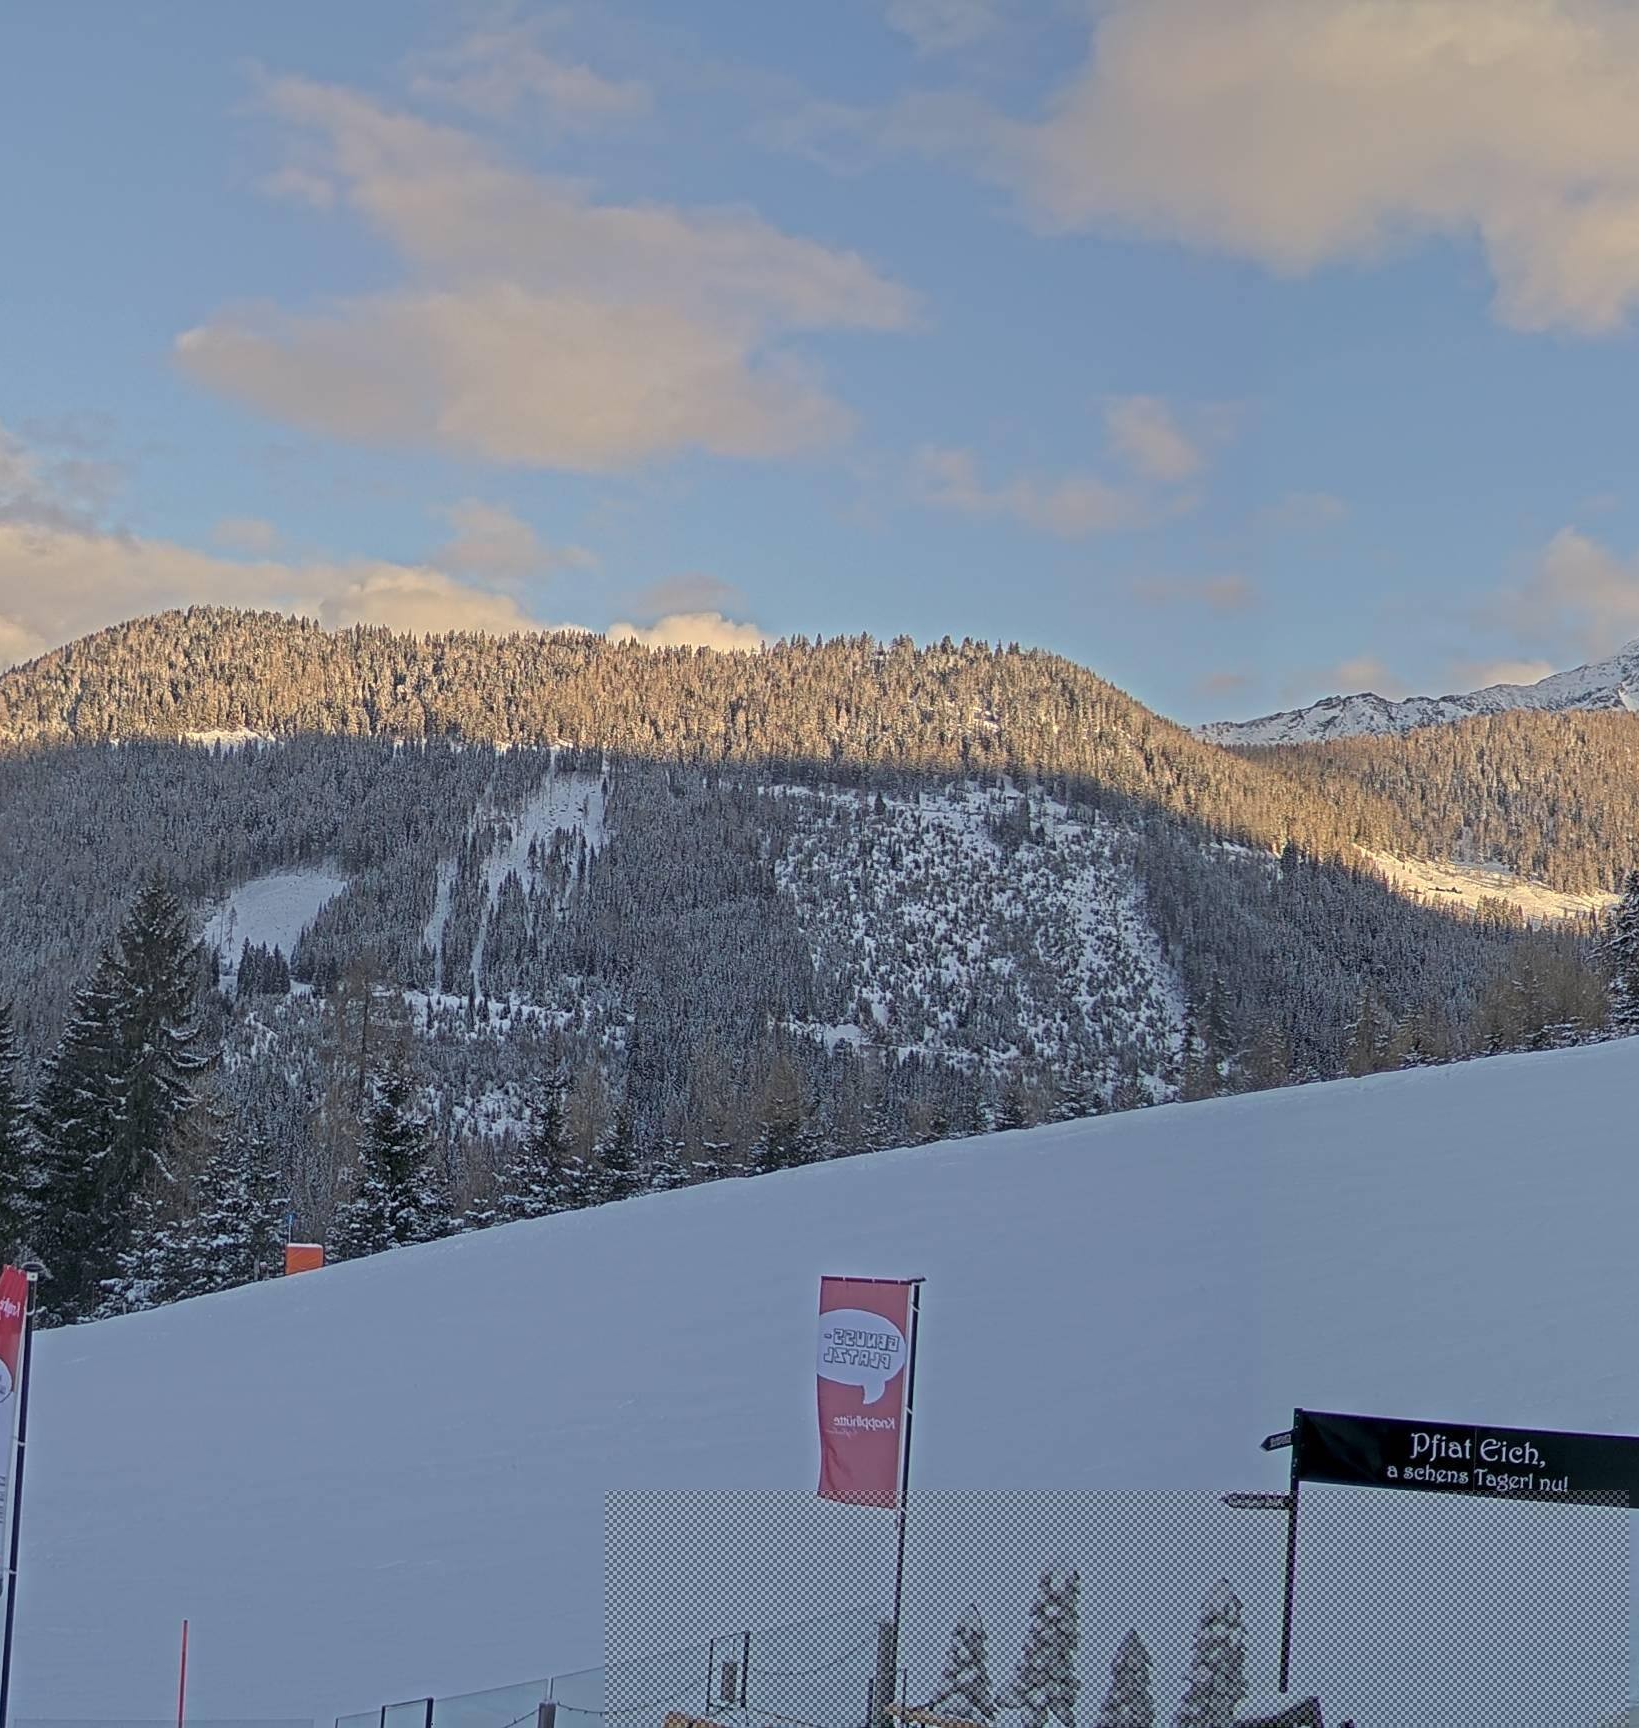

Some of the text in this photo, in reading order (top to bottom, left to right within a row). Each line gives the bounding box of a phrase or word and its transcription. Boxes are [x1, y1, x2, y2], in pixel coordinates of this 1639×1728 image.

[1409, 1432, 1546, 1468] Pfiat Eich,
[1387, 1465, 1398, 1478] a
[1403, 1464, 1470, 1485] schens
[1474, 1468, 1533, 1491] Tagerl
